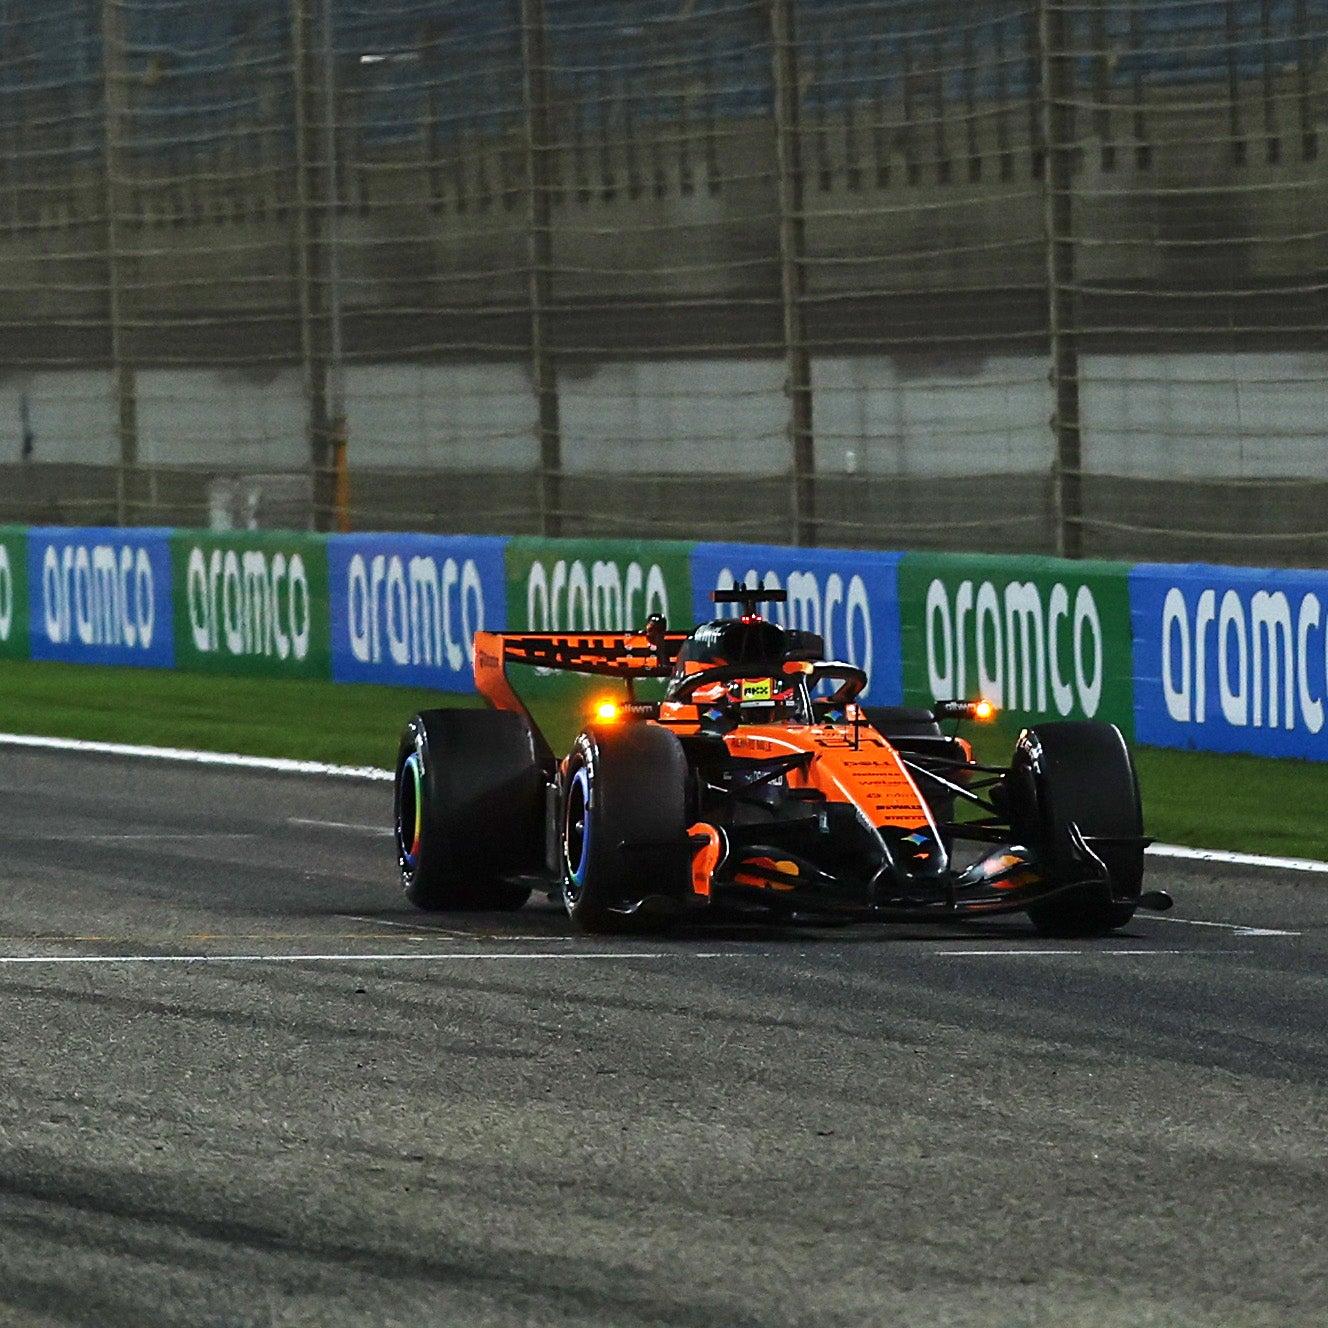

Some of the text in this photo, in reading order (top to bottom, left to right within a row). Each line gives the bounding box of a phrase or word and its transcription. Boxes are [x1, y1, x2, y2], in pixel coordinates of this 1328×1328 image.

[43, 545, 155, 649] aramco
[187, 546, 311, 661] aramco
[348, 553, 485, 672] aramco
[926, 578, 1103, 719] aramco
[1162, 587, 1328, 734] aramc
